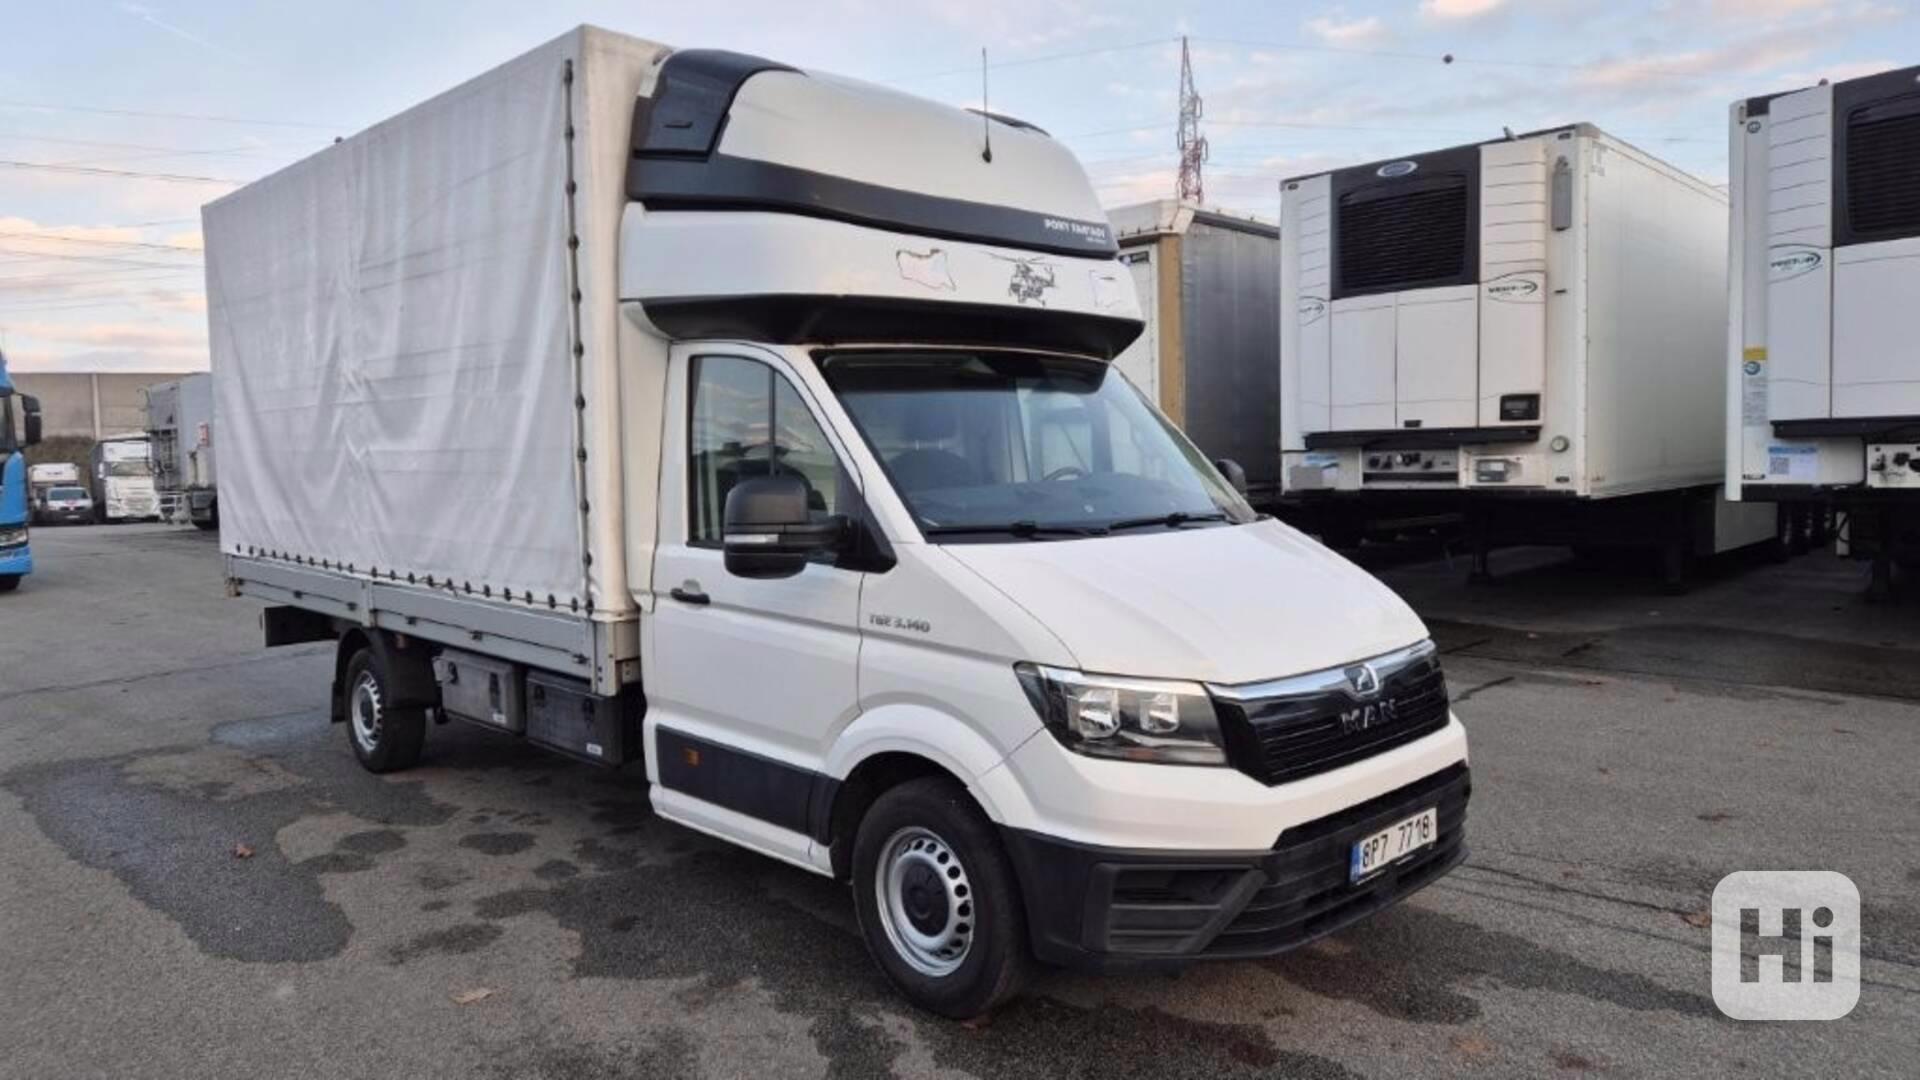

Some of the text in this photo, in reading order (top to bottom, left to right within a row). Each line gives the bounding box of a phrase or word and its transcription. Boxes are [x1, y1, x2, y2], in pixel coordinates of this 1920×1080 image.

[894, 618, 931, 632] 3.140
[1341, 698, 1398, 735] MAN
[1362, 814, 1430, 869] 8P7 7718
